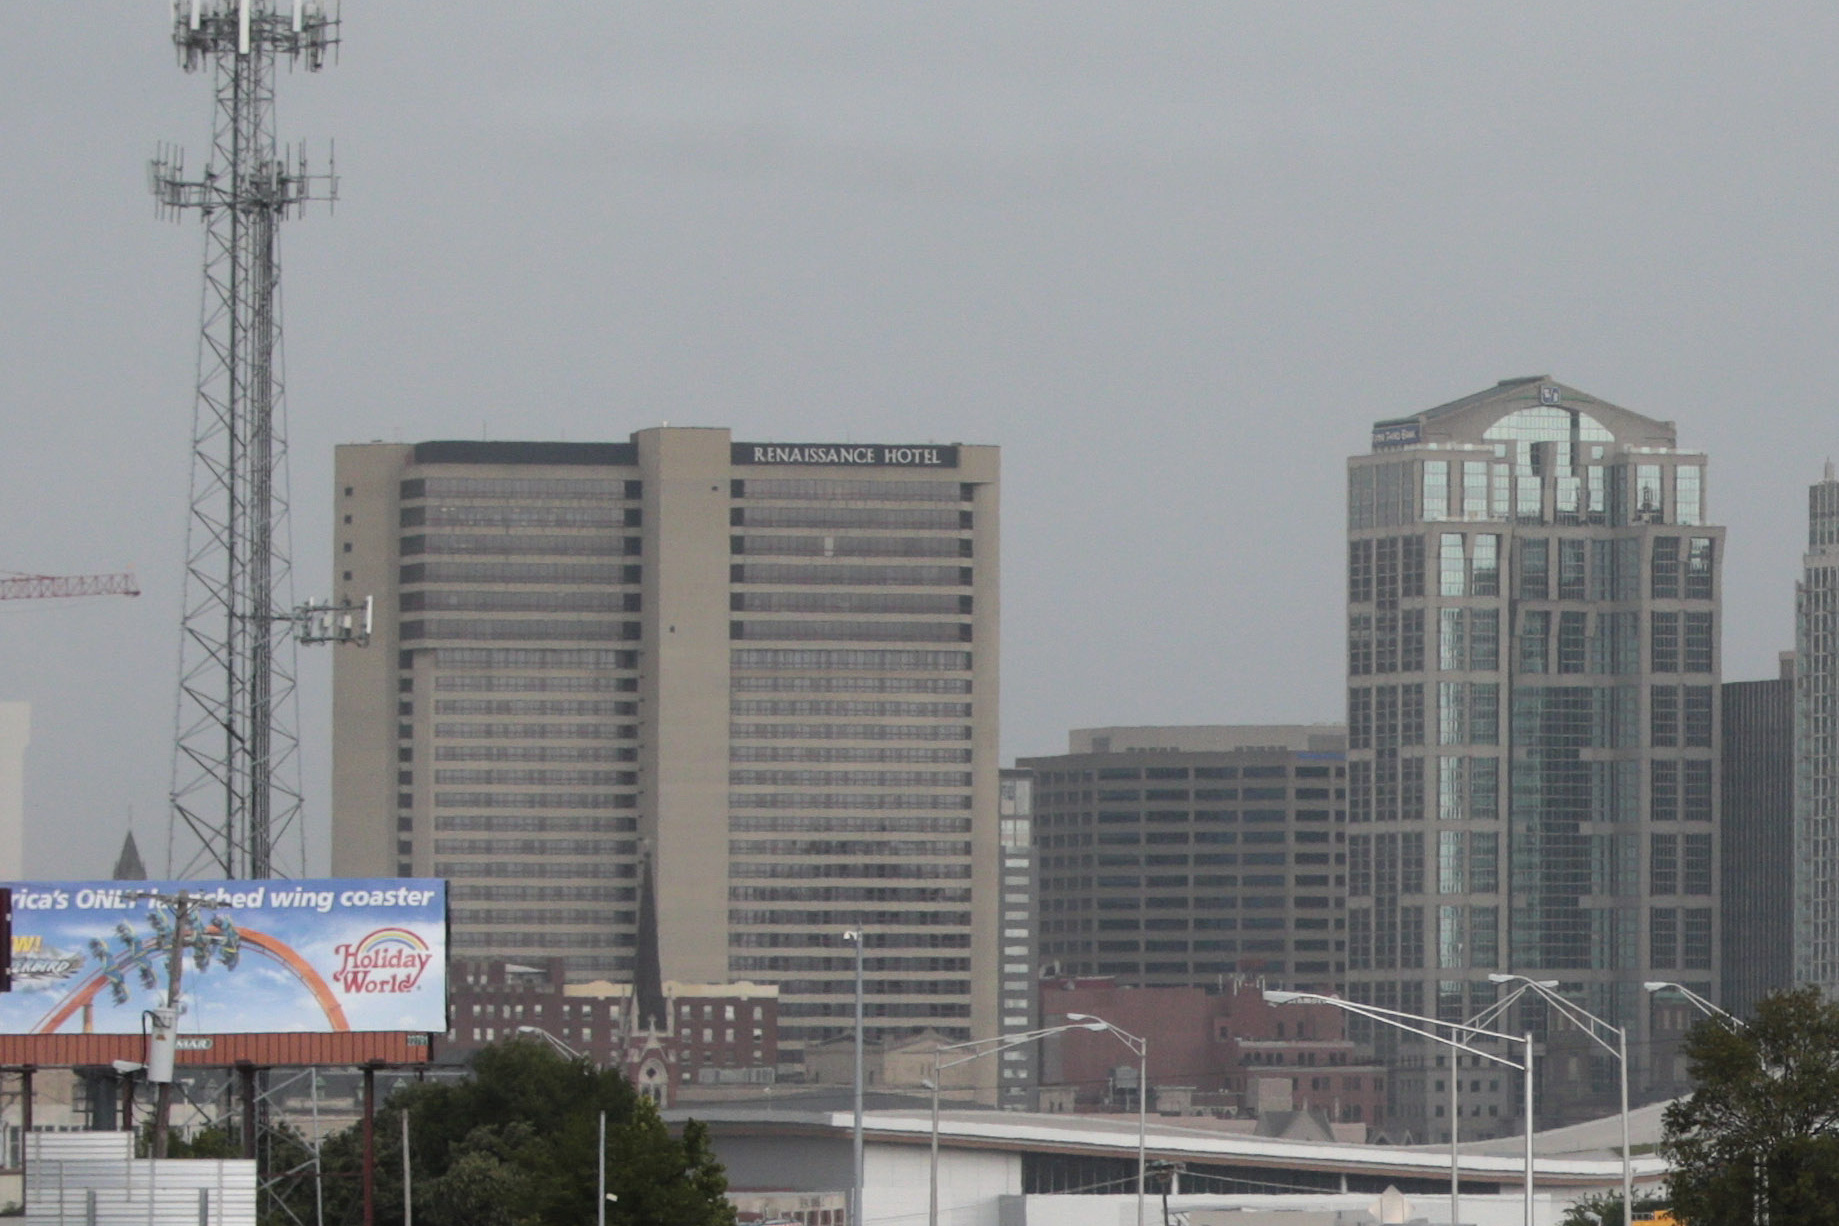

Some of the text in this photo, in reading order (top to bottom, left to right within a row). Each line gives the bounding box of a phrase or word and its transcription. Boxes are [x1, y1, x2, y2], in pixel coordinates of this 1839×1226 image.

[754, 446, 941, 464] RENAISSANCE HOTEL
[148, 887, 265, 909] lached
[271, 887, 335, 913] wing
[340, 887, 435, 907] coaster
[335, 943, 433, 977] Holiday
[333, 970, 412, 994] World
